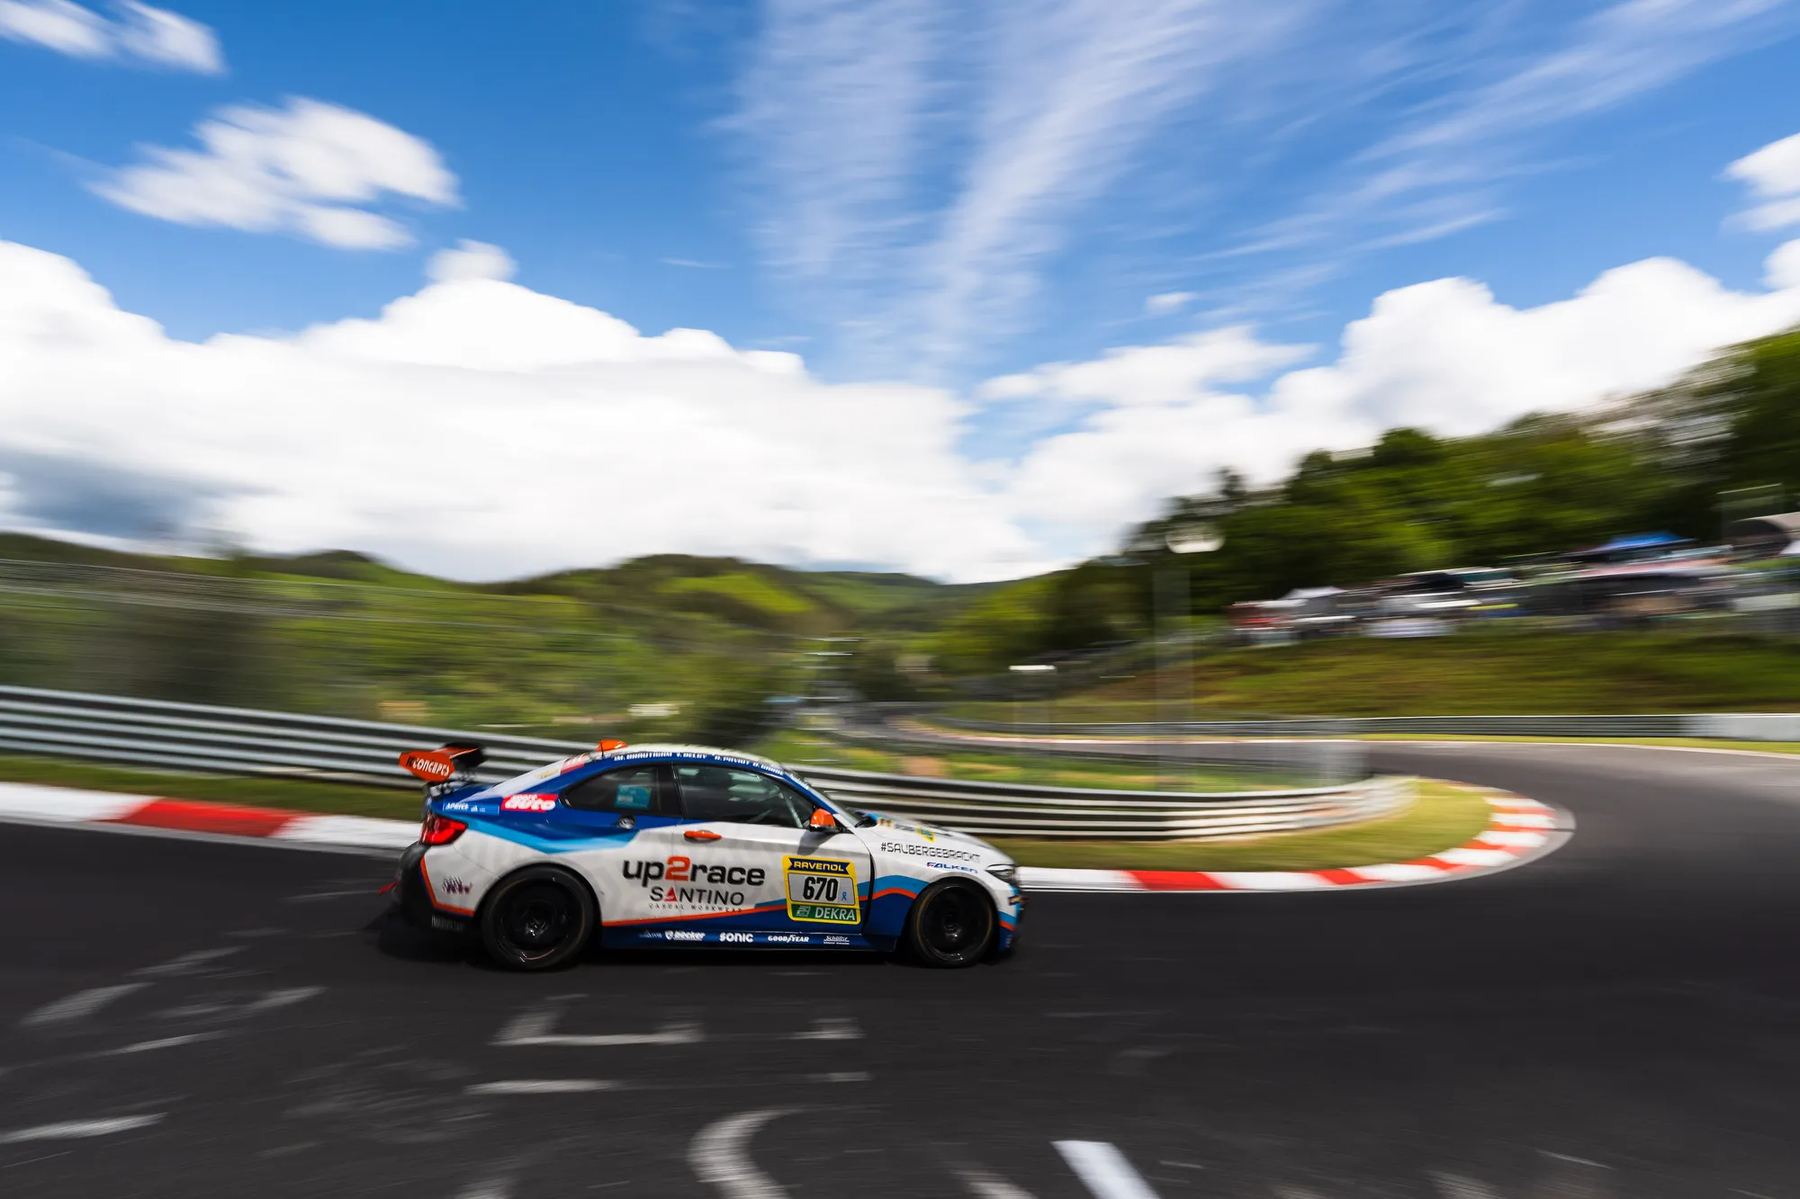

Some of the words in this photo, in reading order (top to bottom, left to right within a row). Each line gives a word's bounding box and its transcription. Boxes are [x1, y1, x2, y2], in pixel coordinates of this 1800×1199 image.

[622, 854, 766, 887] up2race
[793, 861, 845, 872] RAVENOL
[926, 862, 979, 873] FALKEN
[650, 886, 745, 906] SANTINO
[803, 876, 839, 901] 670
[815, 907, 856, 920] DEKRA
